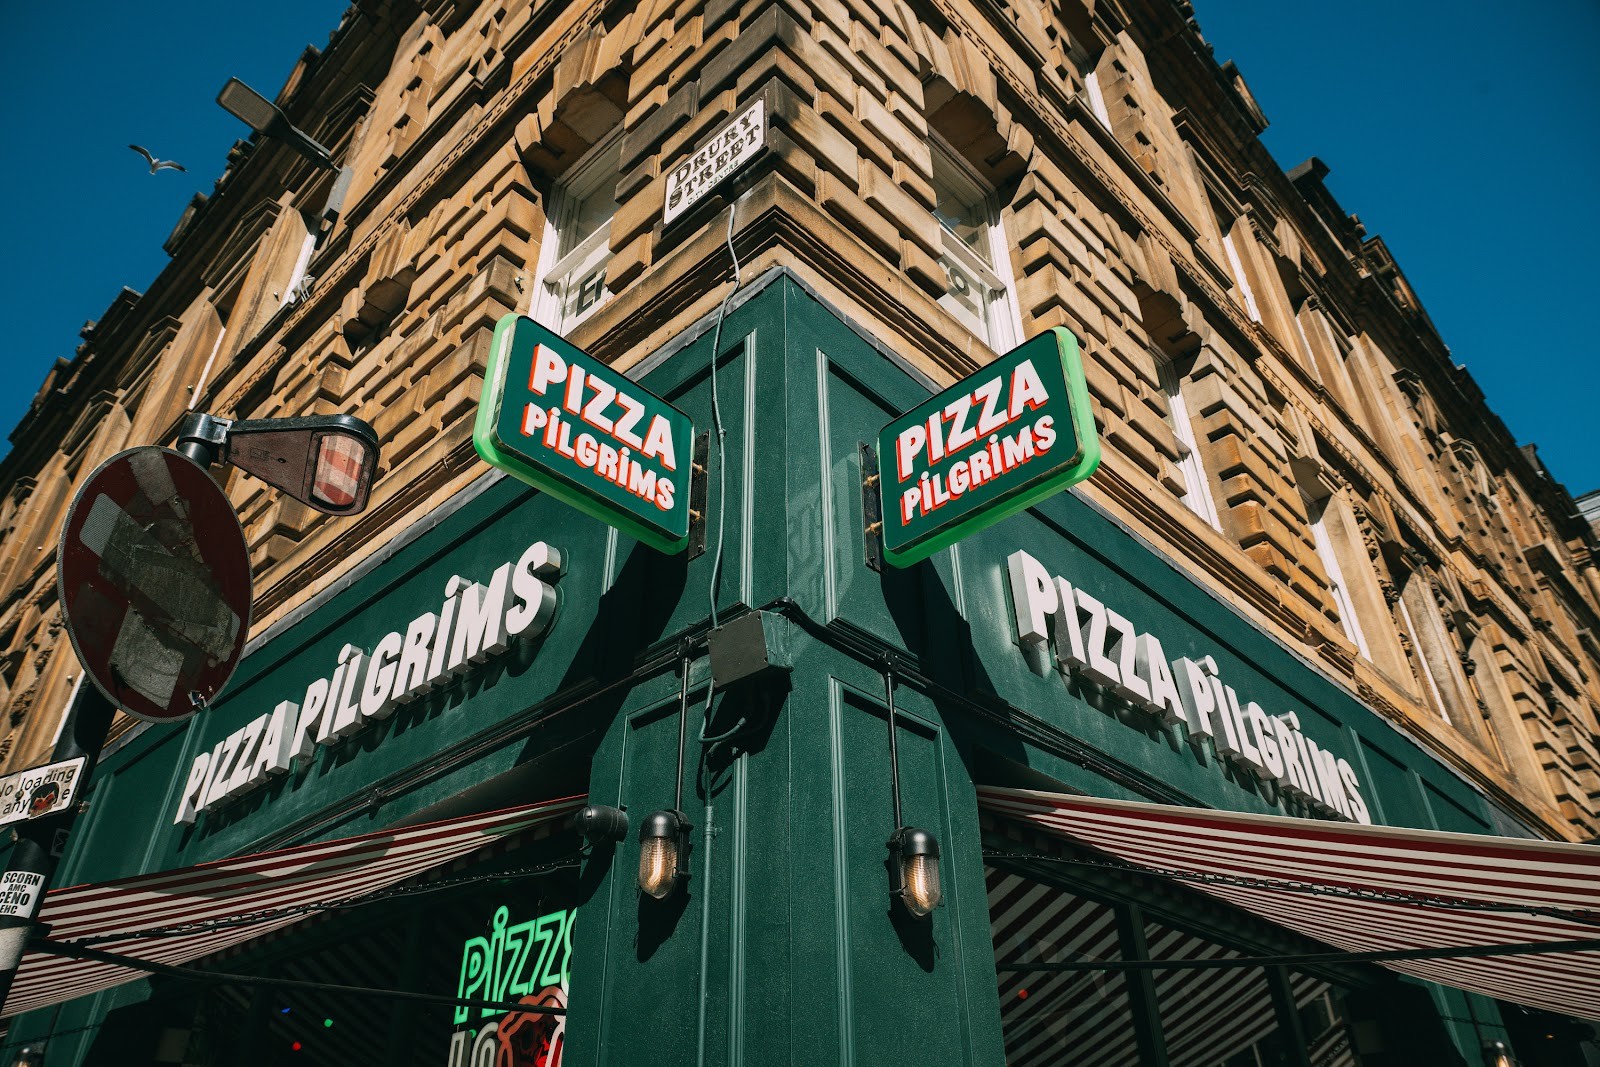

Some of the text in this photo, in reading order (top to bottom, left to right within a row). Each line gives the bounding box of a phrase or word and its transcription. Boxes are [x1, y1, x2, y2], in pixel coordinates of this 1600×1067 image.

[668, 124, 761, 211] STREET
[674, 108, 756, 189] DRURY
[687, 159, 740, 205] CITY CENTRE
[527, 342, 677, 473] PIZZA
[895, 358, 1050, 485] PIZZA
[1007, 548, 1187, 727] PIZZA
[20, 768, 76, 791] loading
[173, 699, 297, 829] PIZZA
[3, 872, 41, 887] SCORN
[7, 883, 27, 893] AMC
